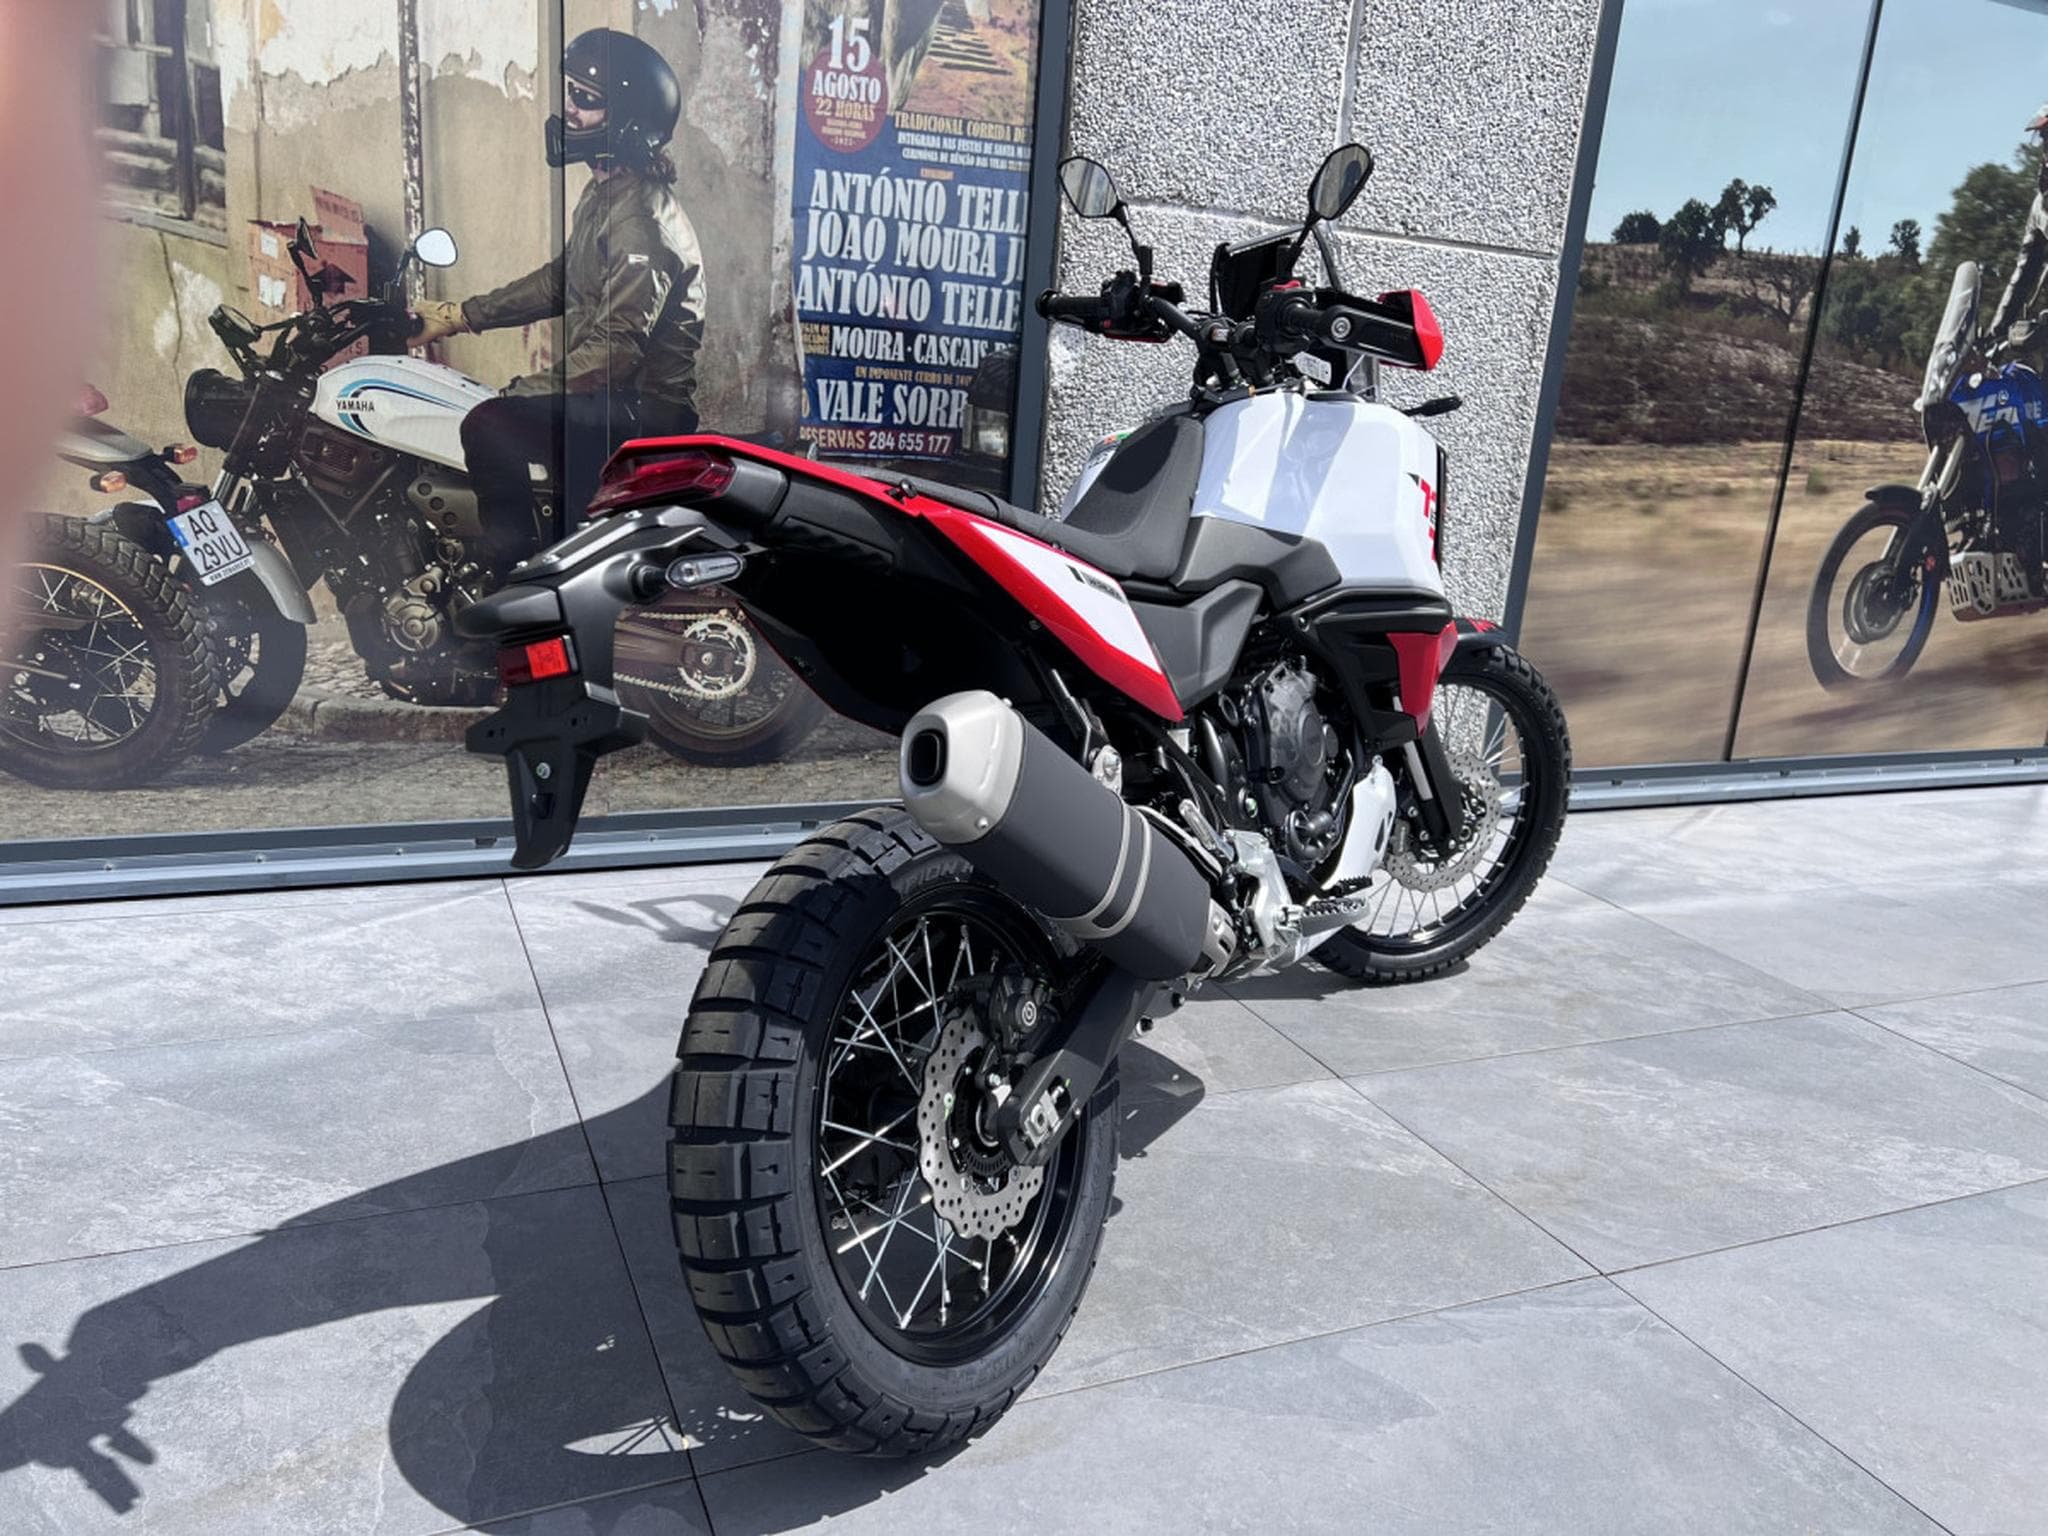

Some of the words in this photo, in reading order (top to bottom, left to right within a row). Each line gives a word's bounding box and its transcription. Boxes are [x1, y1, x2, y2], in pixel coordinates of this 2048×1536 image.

[828, 14, 871, 73] 15
[812, 69, 882, 105] AGOSTO
[815, 97, 833, 116] 22
[835, 100, 876, 122] HORAS
[895, 111, 964, 136] TRADICIONAL
[967, 120, 1012, 140] CORRIDA
[811, 167, 947, 226] ANTÓNIO
[895, 221, 996, 278] MOURA
[797, 265, 931, 322] ANTÓNIO
[941, 281, 1021, 333] TELLE
[336, 400, 376, 412] YAMAHA
[817, 379, 884, 424] VALE
[869, 430, 896, 450] 284
[899, 432, 924, 451] 655
[928, 434, 951, 453] 177
[187, 510, 218, 541] AQ
[194, 532, 243, 570] 29VU
